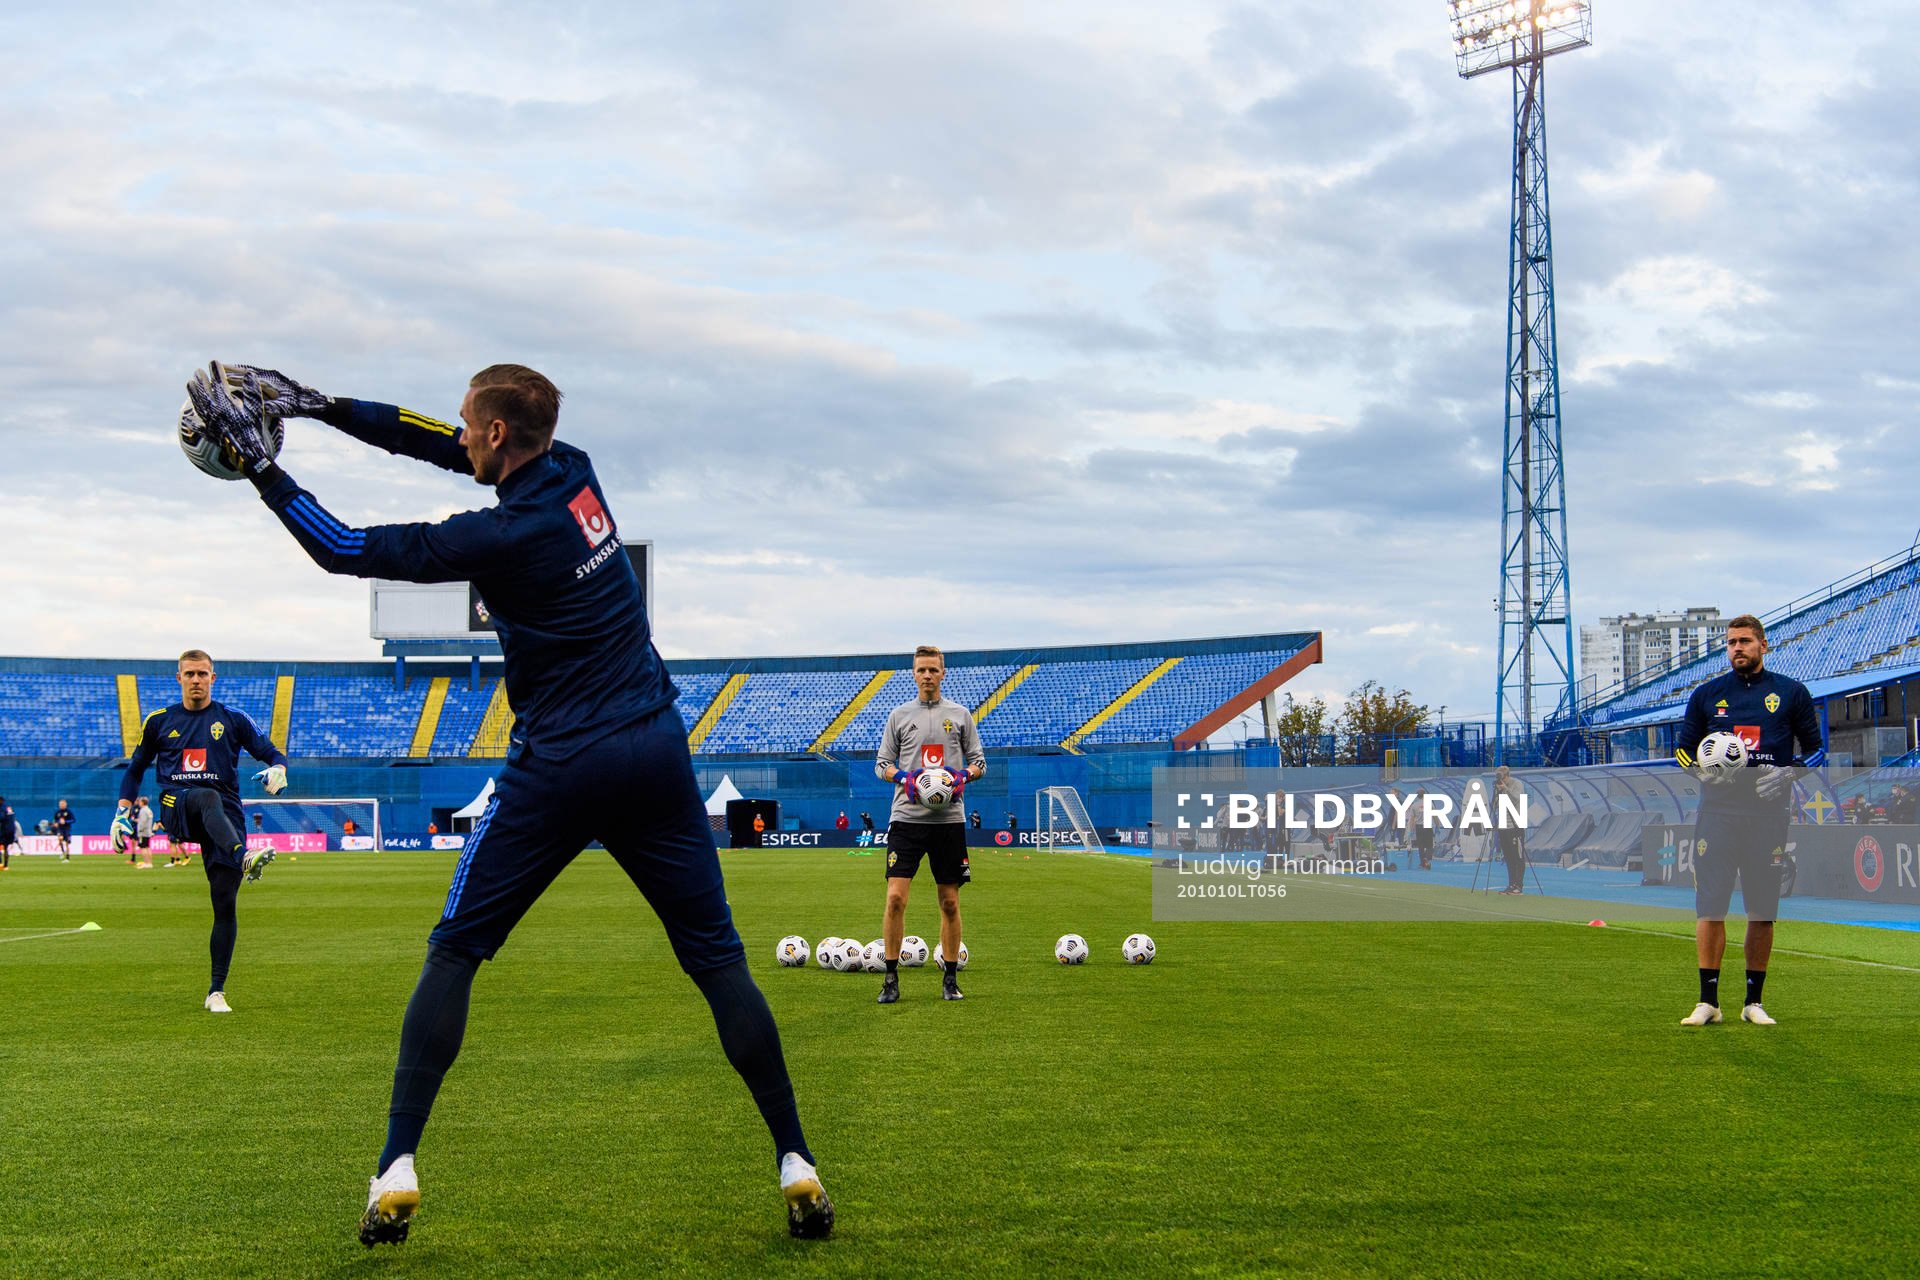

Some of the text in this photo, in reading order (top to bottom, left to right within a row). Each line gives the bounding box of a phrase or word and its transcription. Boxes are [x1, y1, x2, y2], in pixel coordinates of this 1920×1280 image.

[575, 539, 620, 579] SVENSKA
[1755, 753, 1775, 761] SPEL
[171, 773, 201, 781] SVENSKA
[246, 837, 273, 849] MET
[761, 833, 822, 846] ESPECT
